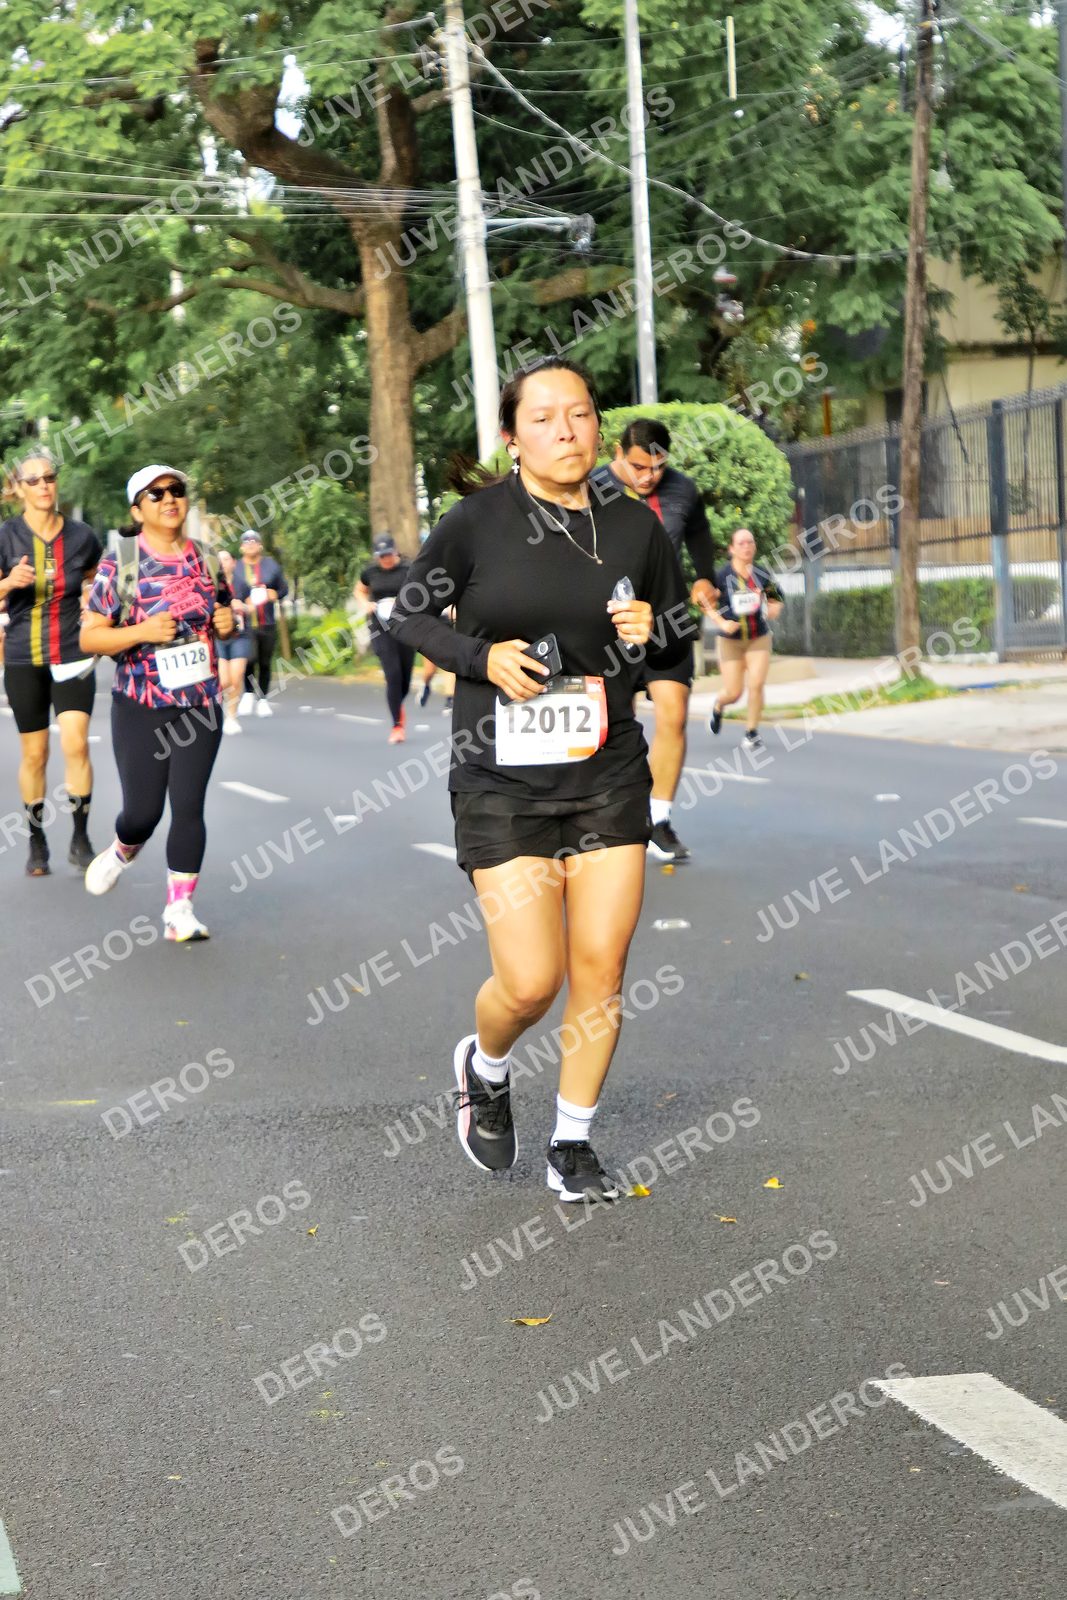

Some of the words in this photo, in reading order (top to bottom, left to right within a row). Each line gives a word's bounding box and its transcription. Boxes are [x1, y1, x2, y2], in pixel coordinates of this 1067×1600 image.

[174, 598, 200, 613] TENIS
[162, 647, 207, 670] 11128
[503, 705, 591, 733] 12012
